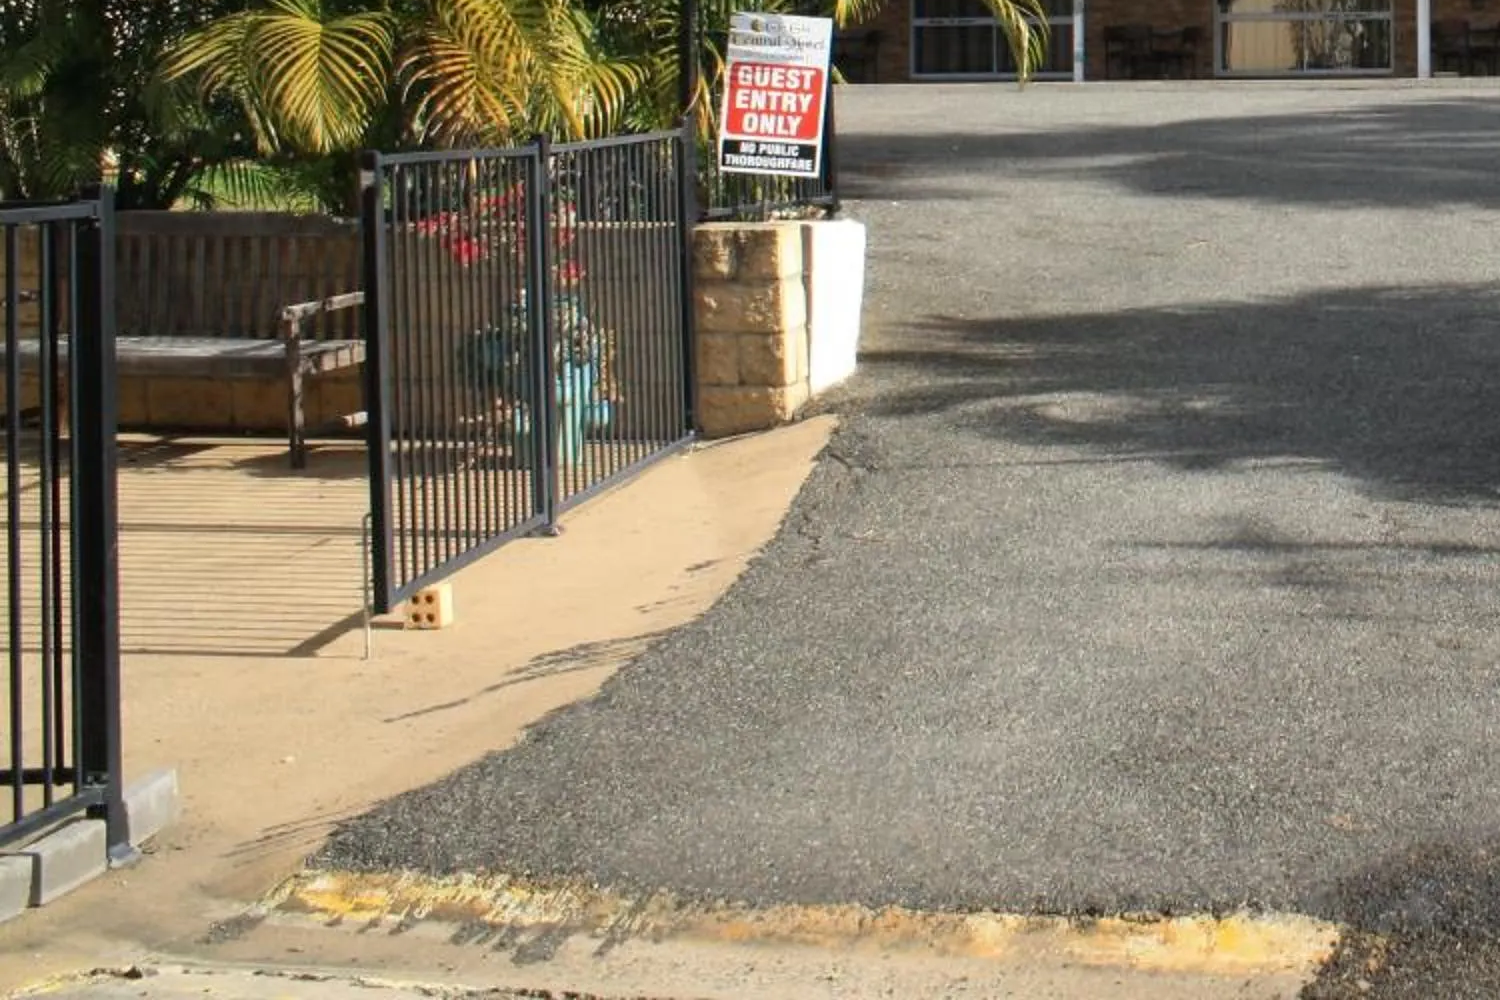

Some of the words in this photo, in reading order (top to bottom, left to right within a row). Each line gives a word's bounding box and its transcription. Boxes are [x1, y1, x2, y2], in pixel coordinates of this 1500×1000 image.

[737, 65, 816, 90] GUEST
[735, 89, 814, 114] ENTRY
[741, 112, 803, 137] ONLY
[740, 141, 757, 154] NO
[759, 142, 800, 156] PUBLIC
[724, 154, 813, 171] THOROUGHFARE
